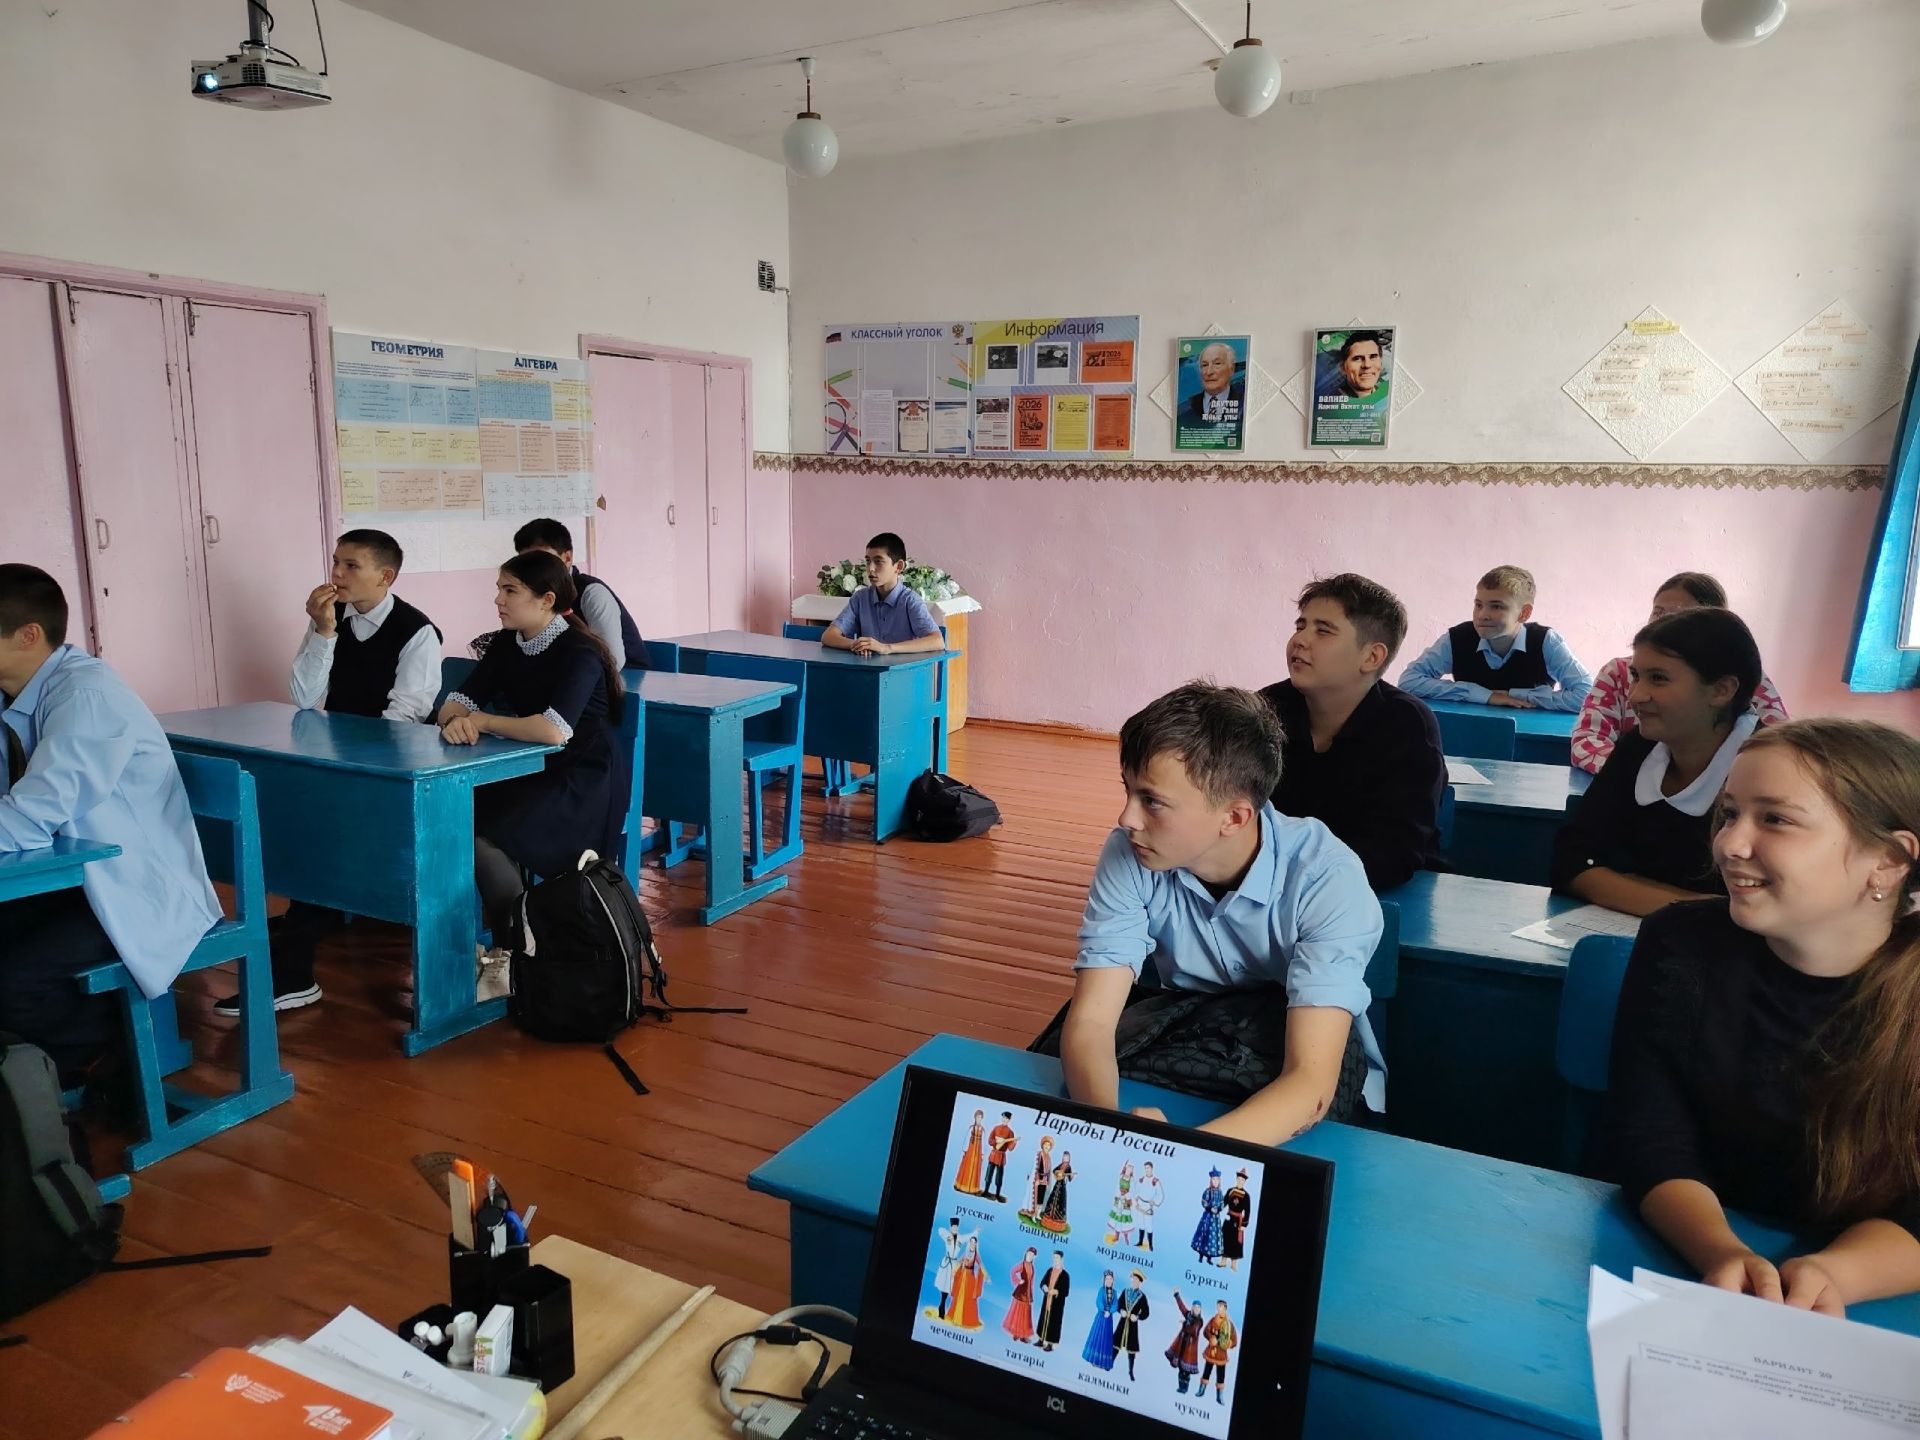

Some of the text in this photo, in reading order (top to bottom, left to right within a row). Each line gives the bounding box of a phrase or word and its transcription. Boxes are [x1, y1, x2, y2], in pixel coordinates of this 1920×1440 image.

[851, 327, 943, 340] КЛАССНЫЙ УГОЛОК
[1005, 321, 1104, 340] Информация
[370, 340, 445, 359] ГЕОМЕТРИЯ
[514, 357, 559, 371] АЛГЕБРА
[1020, 400, 1042, 409] 2026
[1034, 1110, 1178, 1159] Народы России
[955, 1203, 996, 1224] русские
[1018, 1221, 1070, 1246] башкиры
[1096, 1244, 1155, 1270] мордовцы
[1184, 1268, 1230, 1292] буряты
[929, 1323, 975, 1347] чеченцы
[1004, 1347, 1046, 1370] татары
[1753, 1356, 1814, 1376] ВАРИАНТ
[1077, 1372, 1131, 1397] калмыки
[1174, 1401, 1211, 1422] чукчи
